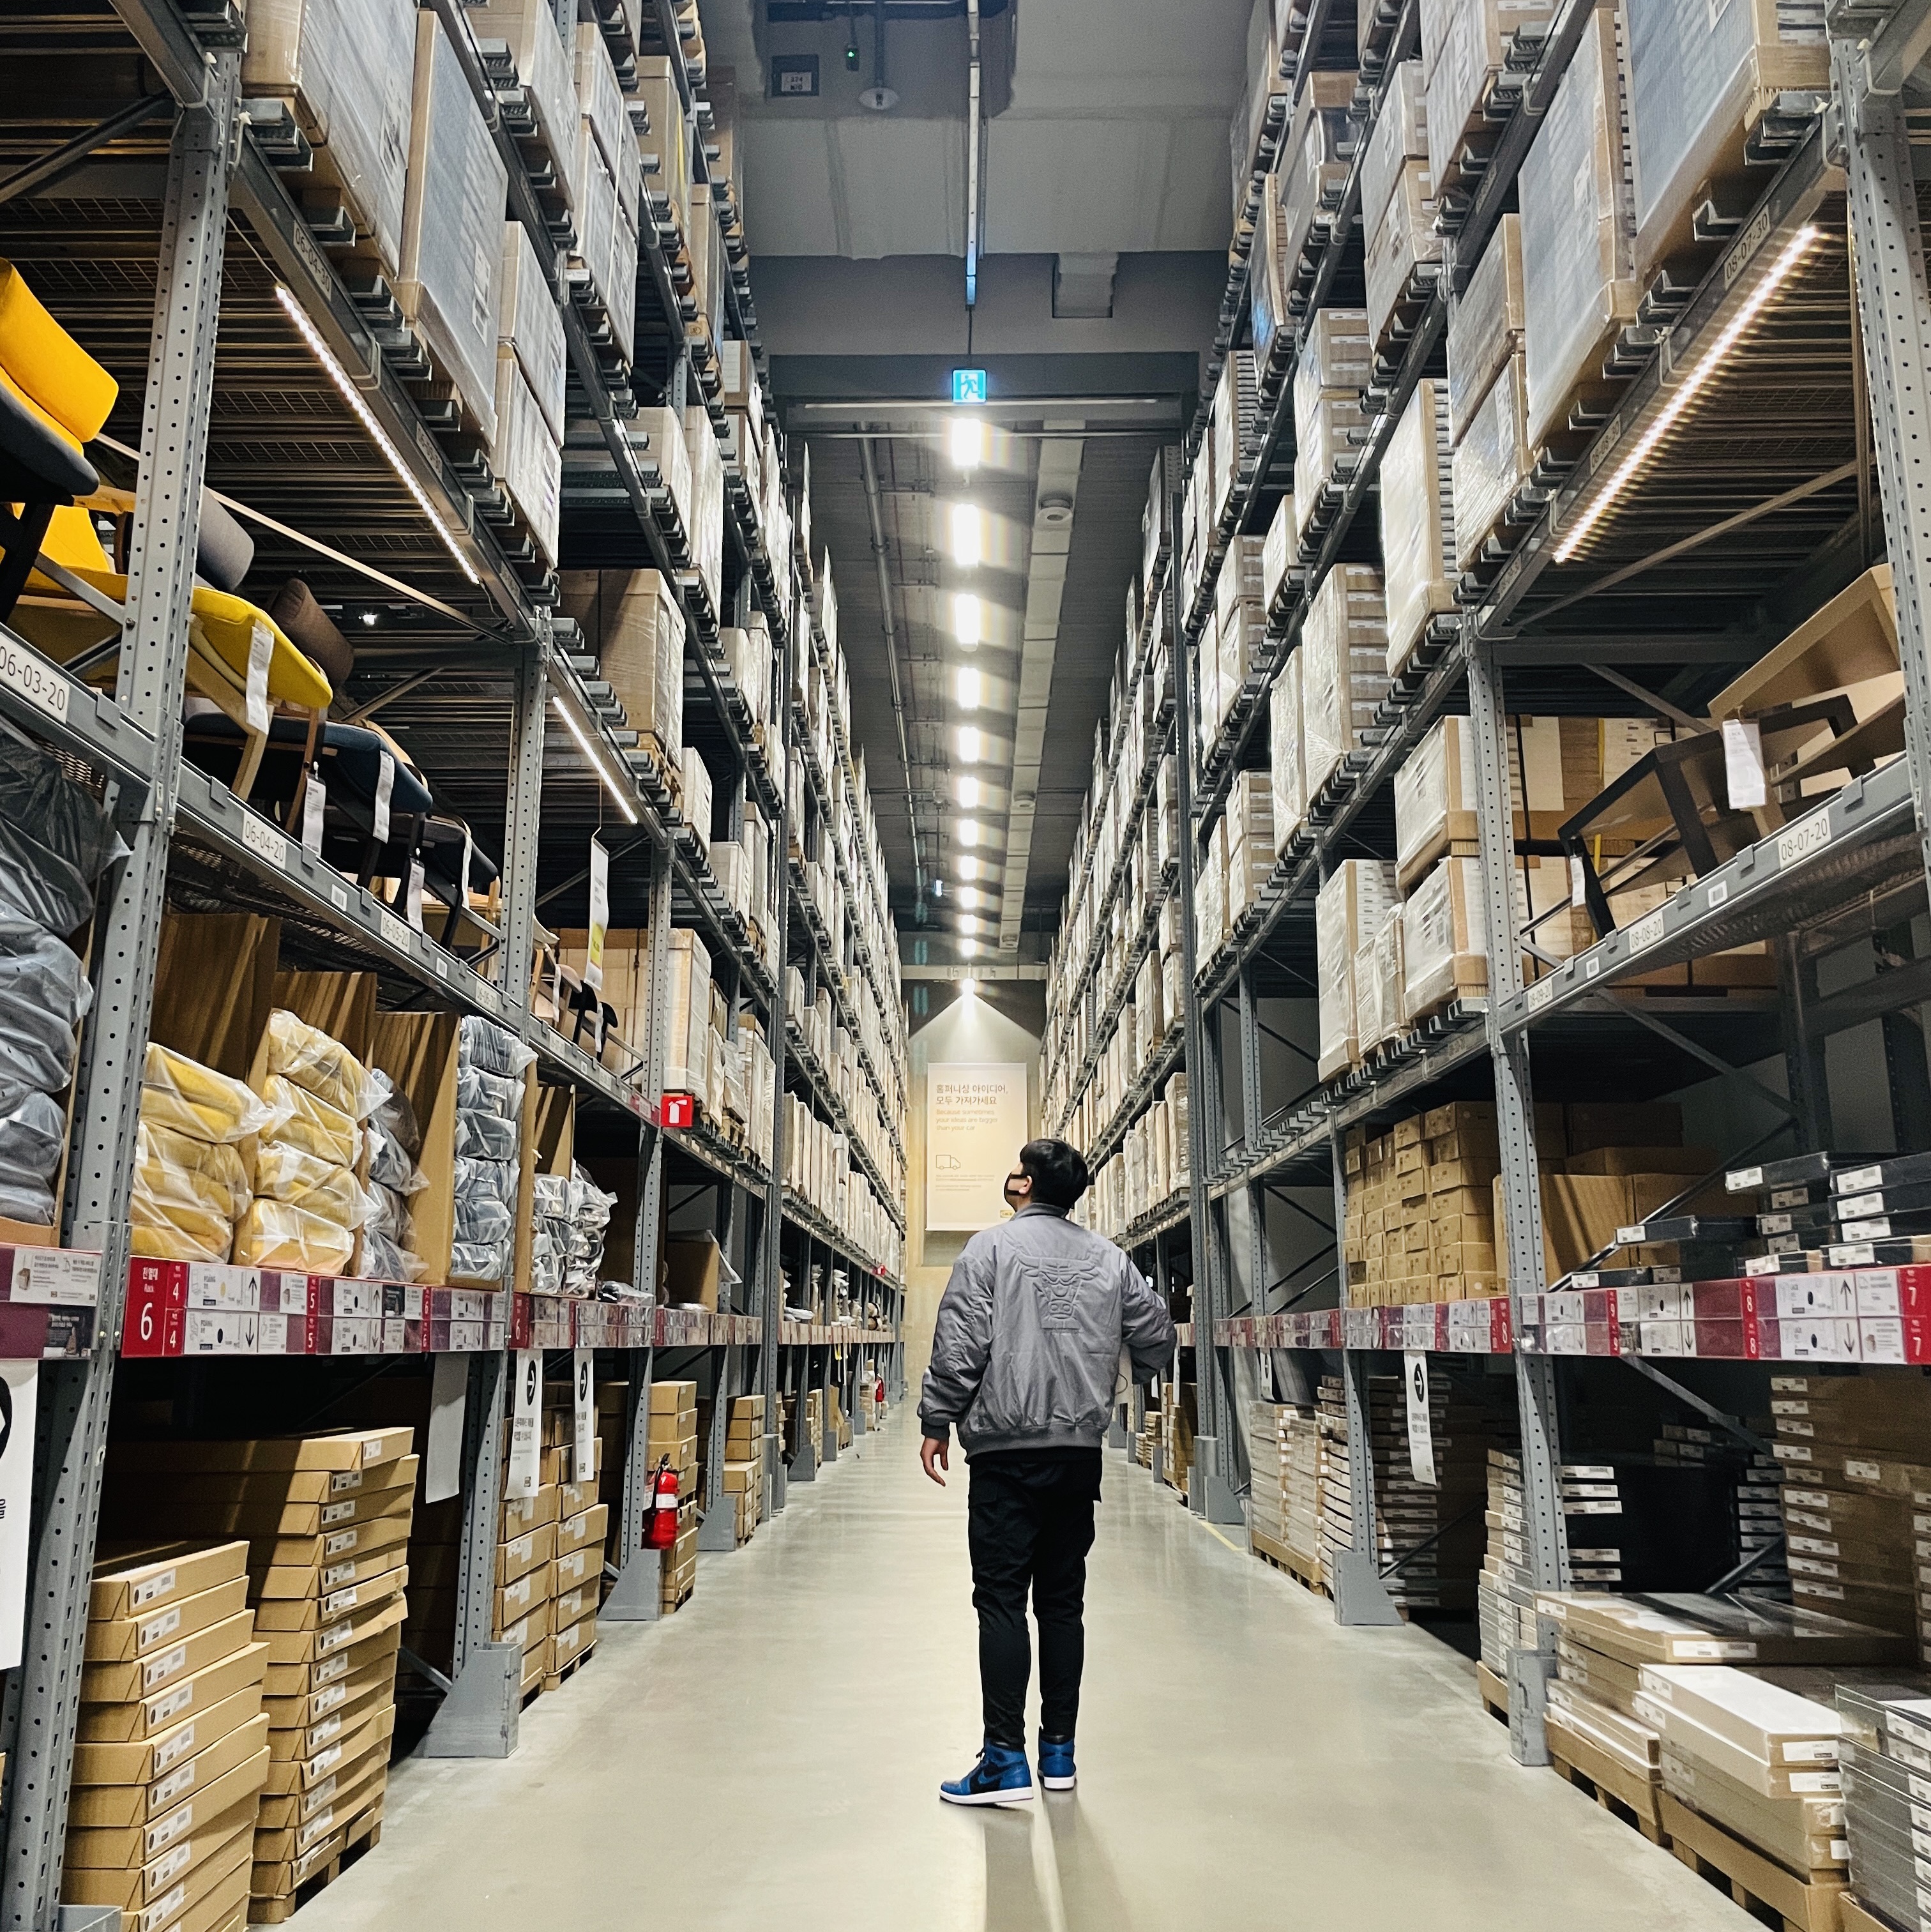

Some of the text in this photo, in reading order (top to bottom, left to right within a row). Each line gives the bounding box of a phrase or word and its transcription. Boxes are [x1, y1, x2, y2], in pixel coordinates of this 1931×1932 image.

[1726, 213, 1768, 280] 08-07-30
[295, 227, 330, 292] 06-04-30
[0, 646, 65, 711] 06-03-20
[245, 821, 284, 862] 06-04-20
[1781, 818, 1828, 860] 08-07-20
[382, 917, 409, 947] 06-05-20
[1631, 918, 1662, 948] 08-08-20
[936, 1084, 1008, 1094] 홈퍼니싱 아이디어,
[936, 1096, 997, 1106] 모두 가져가세요
[142, 1267, 158, 1281] 진열대
[172, 1282, 179, 1300] 4
[309, 1293, 315, 1309] 5
[424, 1300, 429, 1315] 6
[1746, 1296, 1753, 1312] 8
[140, 1302, 153, 1341] 6
[169, 1330, 176, 1348] 4
[308, 1332, 313, 1348] 5
[1501, 1321, 1508, 1344] 8
[1750, 1338, 1756, 1354] 8
